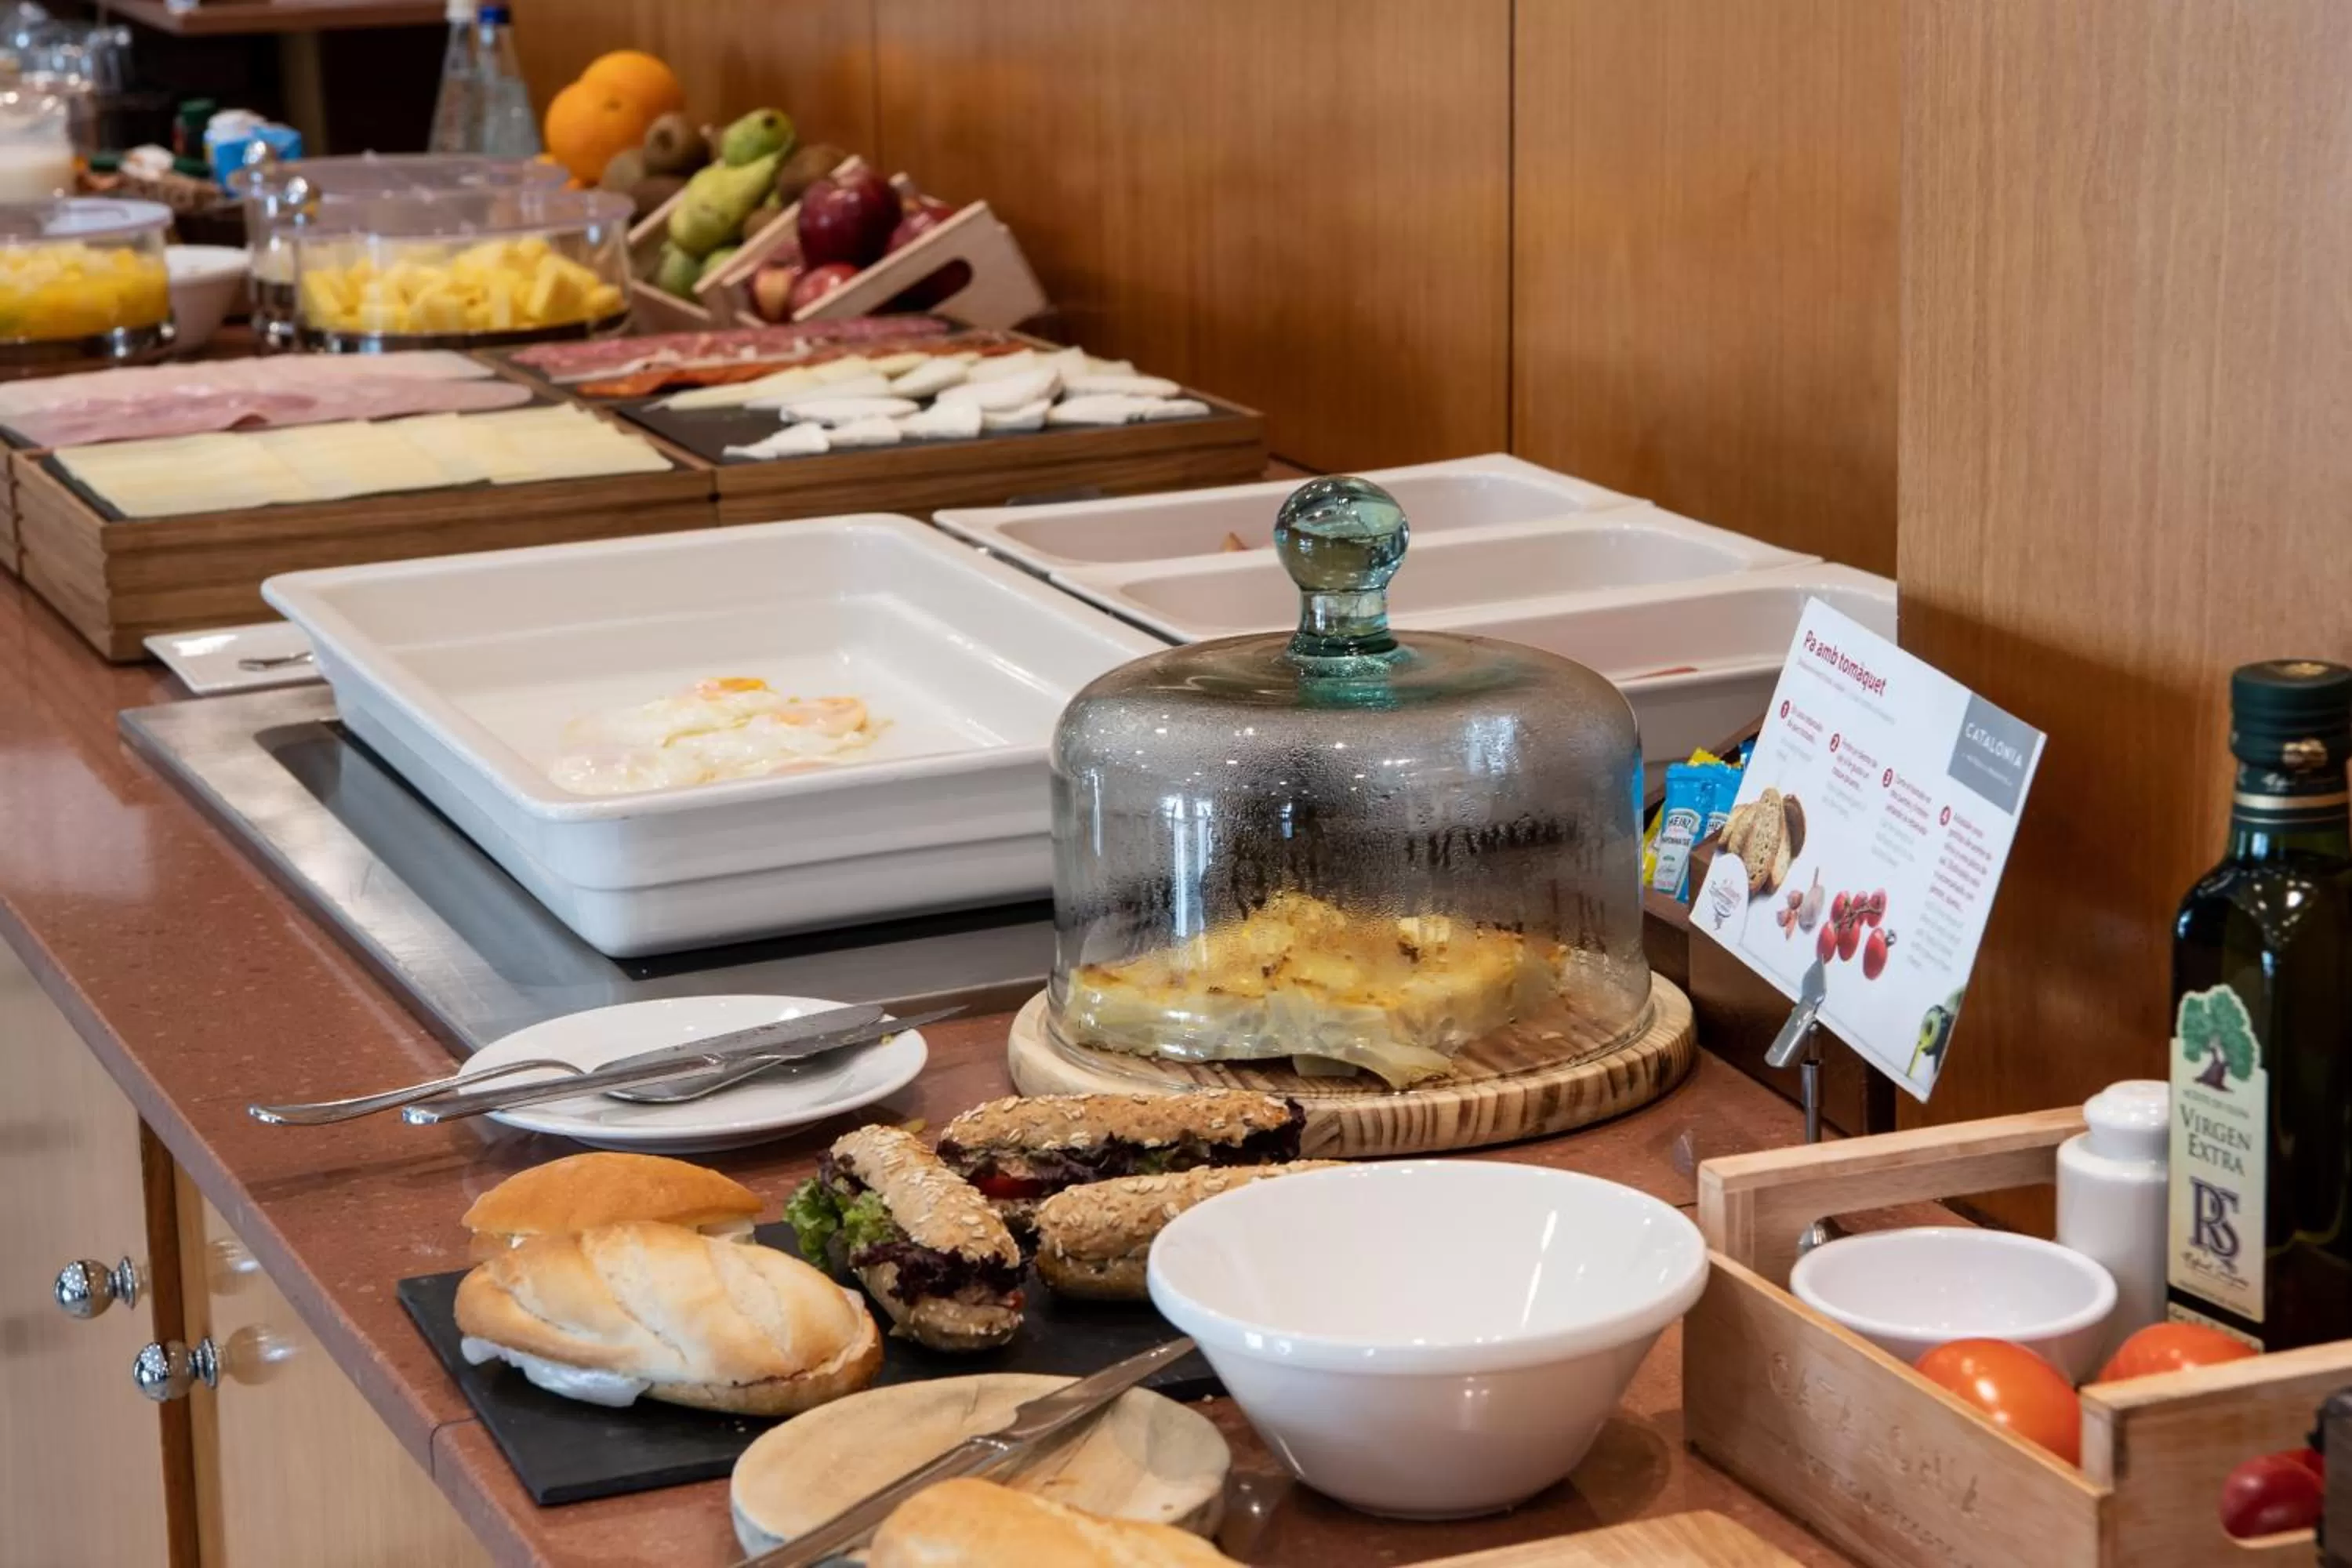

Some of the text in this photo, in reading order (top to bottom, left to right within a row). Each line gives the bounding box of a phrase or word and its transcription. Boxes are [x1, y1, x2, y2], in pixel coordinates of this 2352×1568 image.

[1804, 630, 1817, 652] Pa
[1816, 643, 1838, 666] amb
[1965, 722, 2023, 769] CATALONIA
[1668, 816, 1693, 829] HEINZ
[2179, 1103, 2252, 1151] VIRGEN
[2188, 1132, 2245, 1178] EXTRA
